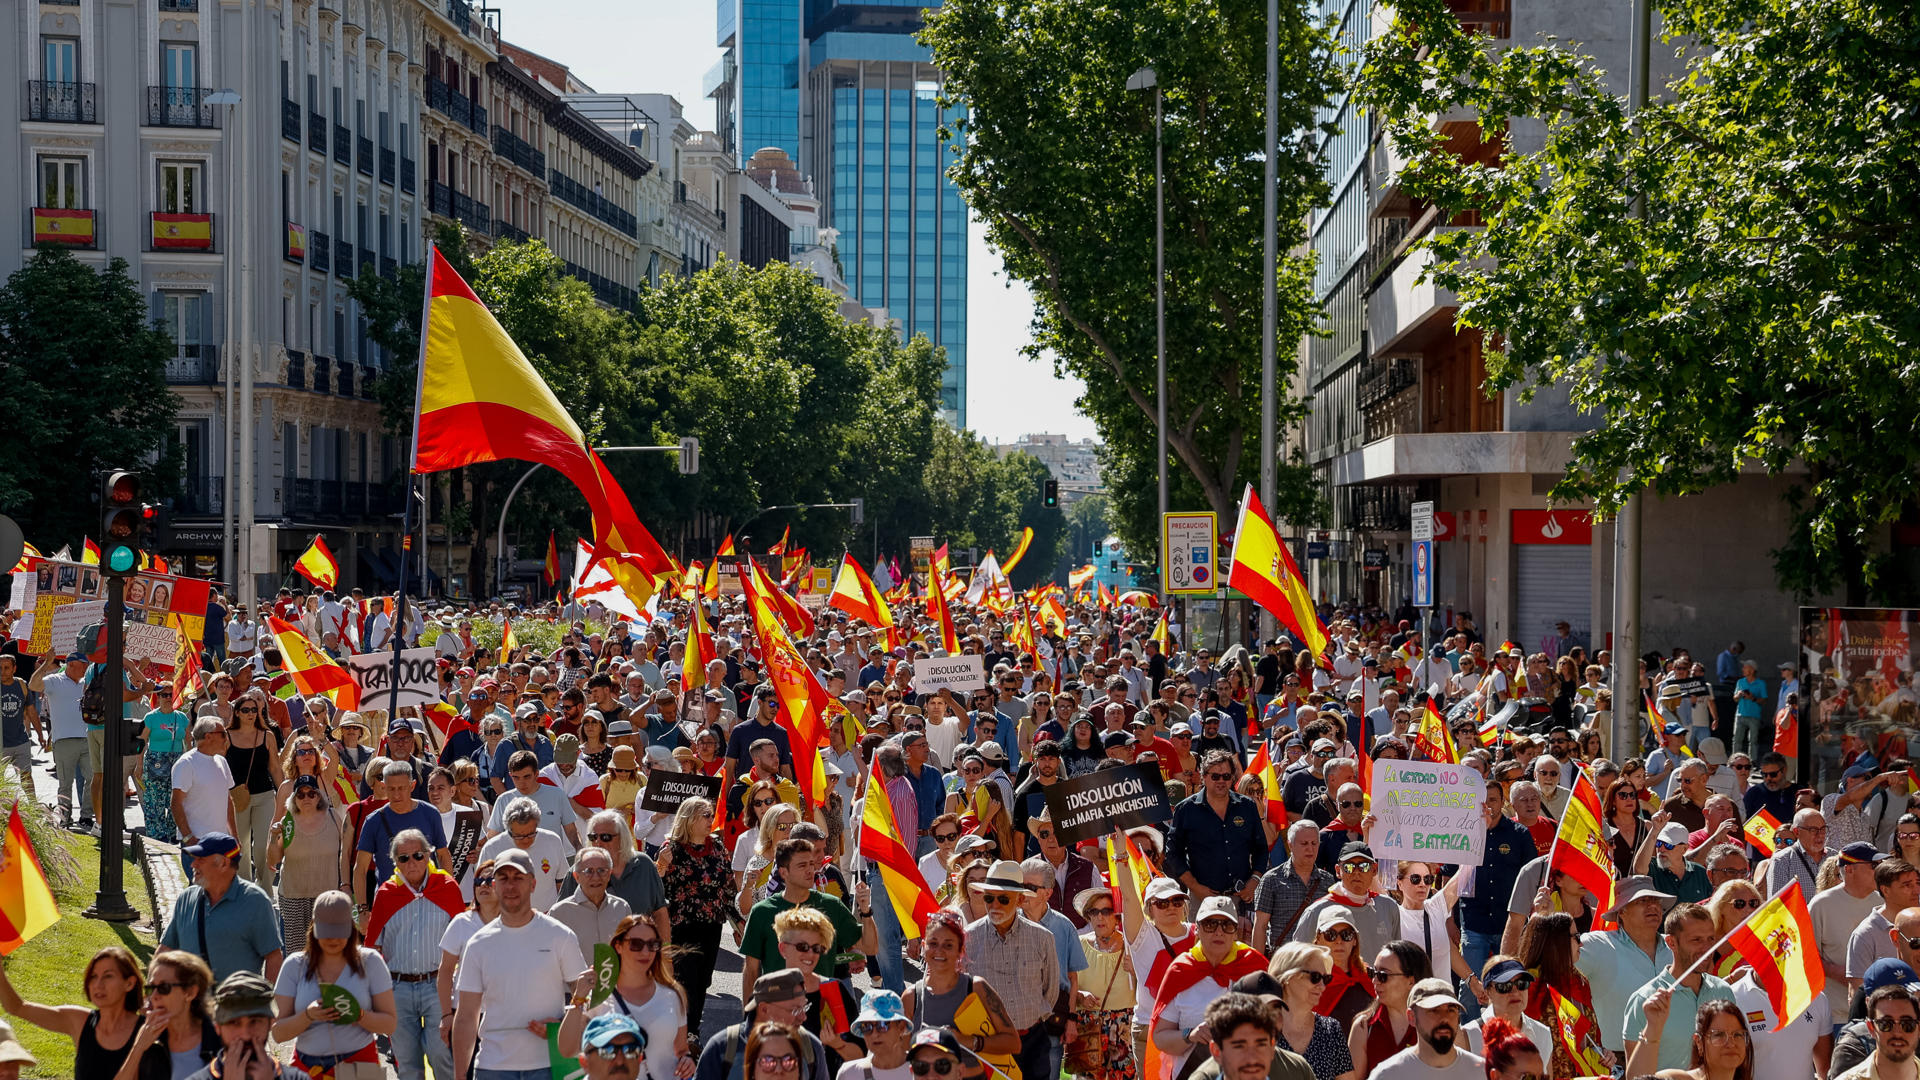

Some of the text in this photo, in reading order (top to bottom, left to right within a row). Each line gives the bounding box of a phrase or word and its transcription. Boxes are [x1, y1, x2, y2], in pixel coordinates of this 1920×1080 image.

[1850, 635, 1873, 645] Dale
[1850, 648, 1857, 656] a
[1857, 647, 1868, 656] tu
[932, 676, 948, 684] MAFIA
[662, 781, 709, 796] ¡DISOLUCIÓN
[1065, 777, 1144, 811] ¡DISOLUCIÓN
[1306, 785, 1327, 794] JAC
[663, 794, 680, 803] MAFIA
[1061, 794, 1159, 829] DE LA MAFIA SANCHISTA!!
[284, 820, 292, 840] VOX
[1456, 812, 1480, 830] dar
[1384, 829, 1403, 848] LA
[454, 828, 475, 879] ¡DISOLUCIÓ
[600, 956, 614, 992] VOX
[334, 994, 354, 1016] VOX
[1751, 1024, 1767, 1032] ESP
